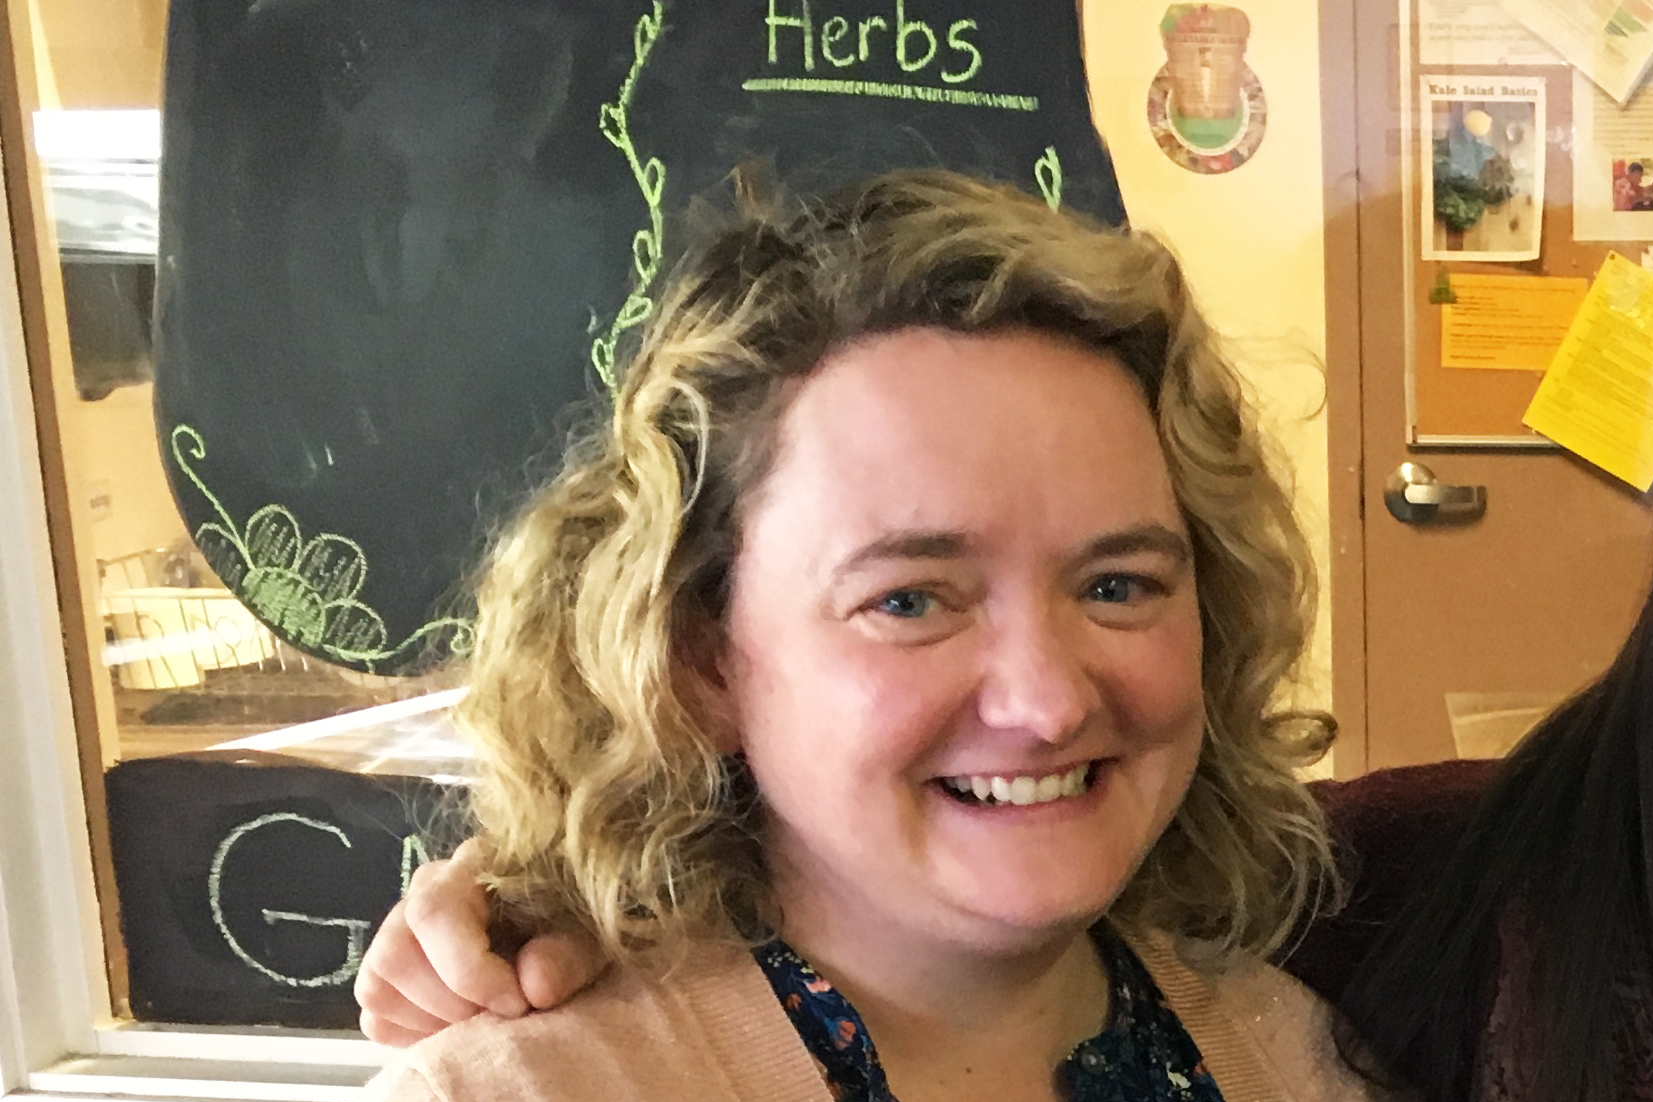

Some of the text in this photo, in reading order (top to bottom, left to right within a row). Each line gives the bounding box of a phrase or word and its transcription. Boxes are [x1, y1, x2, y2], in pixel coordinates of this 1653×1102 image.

[765, 0, 982, 83] Herbs
[1428, 84, 1457, 95] Kale
[1462, 85, 1495, 96] Salad
